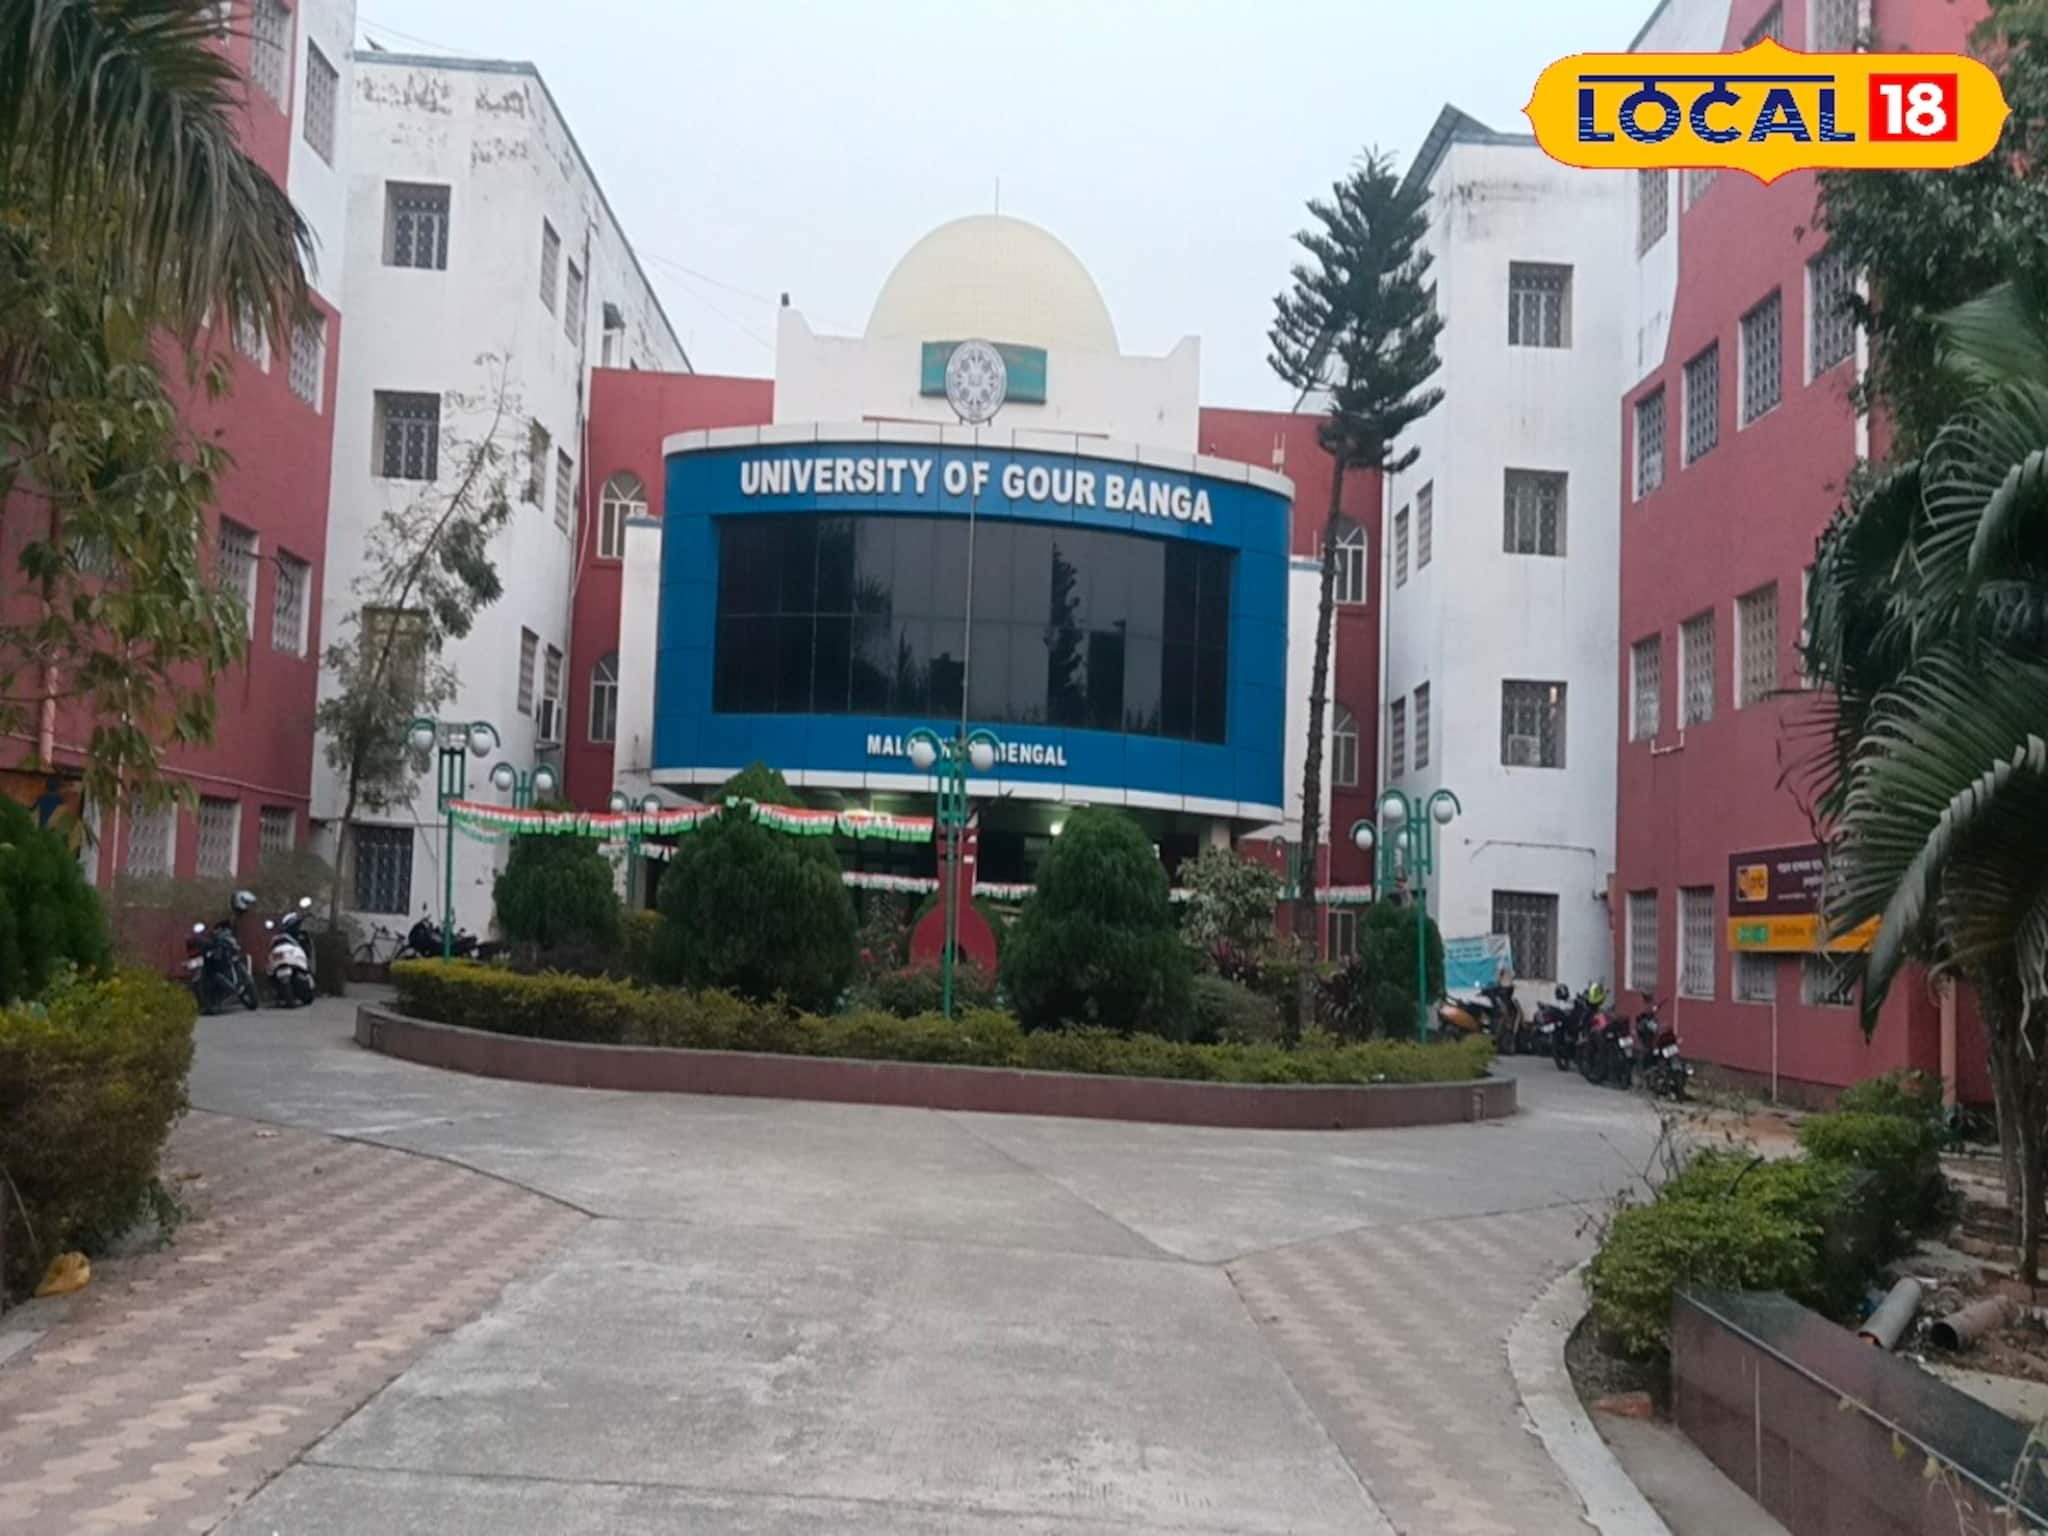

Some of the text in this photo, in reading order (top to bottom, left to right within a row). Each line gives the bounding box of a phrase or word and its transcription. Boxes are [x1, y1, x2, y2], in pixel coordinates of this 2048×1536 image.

[740, 457, 1213, 526] UNIVERSITY OF GOUR BANGA
